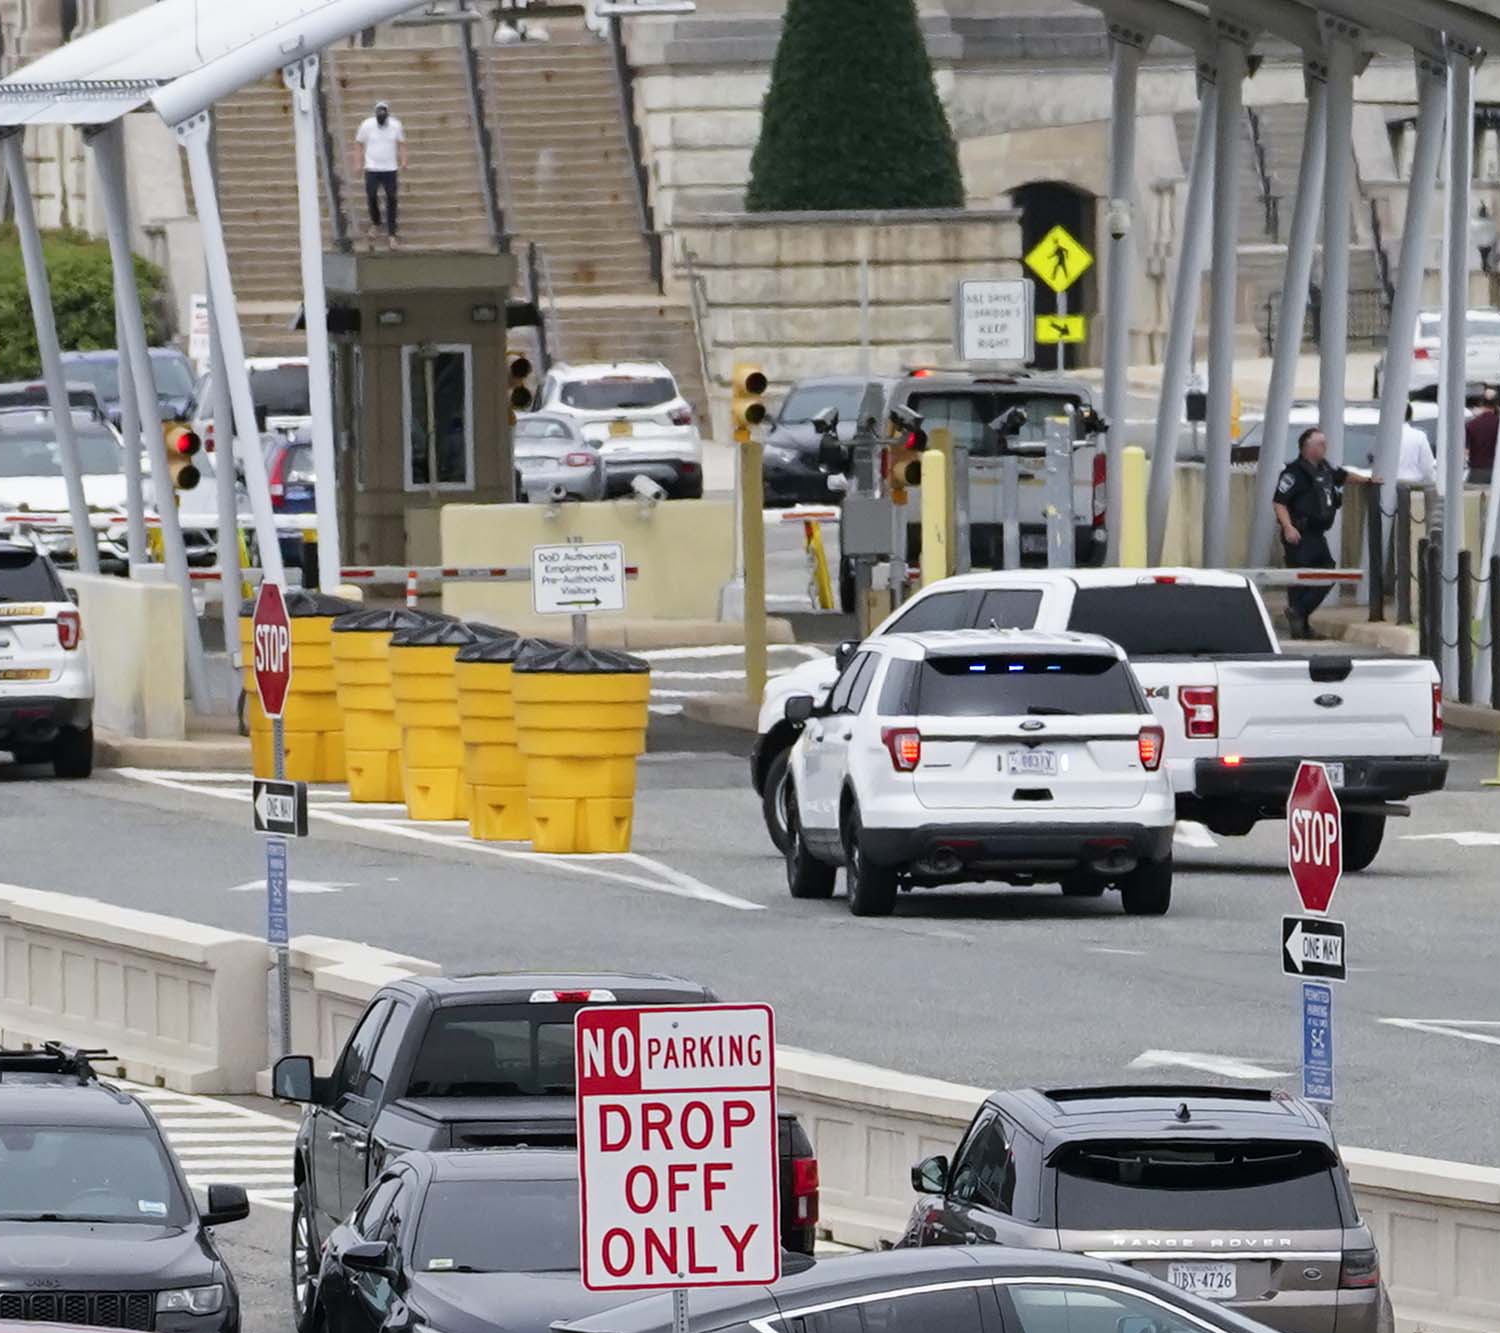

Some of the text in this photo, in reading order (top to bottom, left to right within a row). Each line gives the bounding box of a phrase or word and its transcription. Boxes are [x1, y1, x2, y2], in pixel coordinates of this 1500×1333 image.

[544, 563, 598, 576] Employees
[563, 550, 617, 561] Authorized
[560, 585, 597, 596] Visitors
[256, 623, 289, 673] STOP
[1291, 807, 1338, 869] STOP
[1302, 936, 1340, 962] ONE WAY
[581, 1027, 763, 1078] NO PARKING
[600, 1099, 757, 1152] DROP
[624, 1162, 734, 1214] OFF
[600, 1223, 760, 1277] ONLY
[1111, 1237, 1292, 1248] RANGE ROVER
